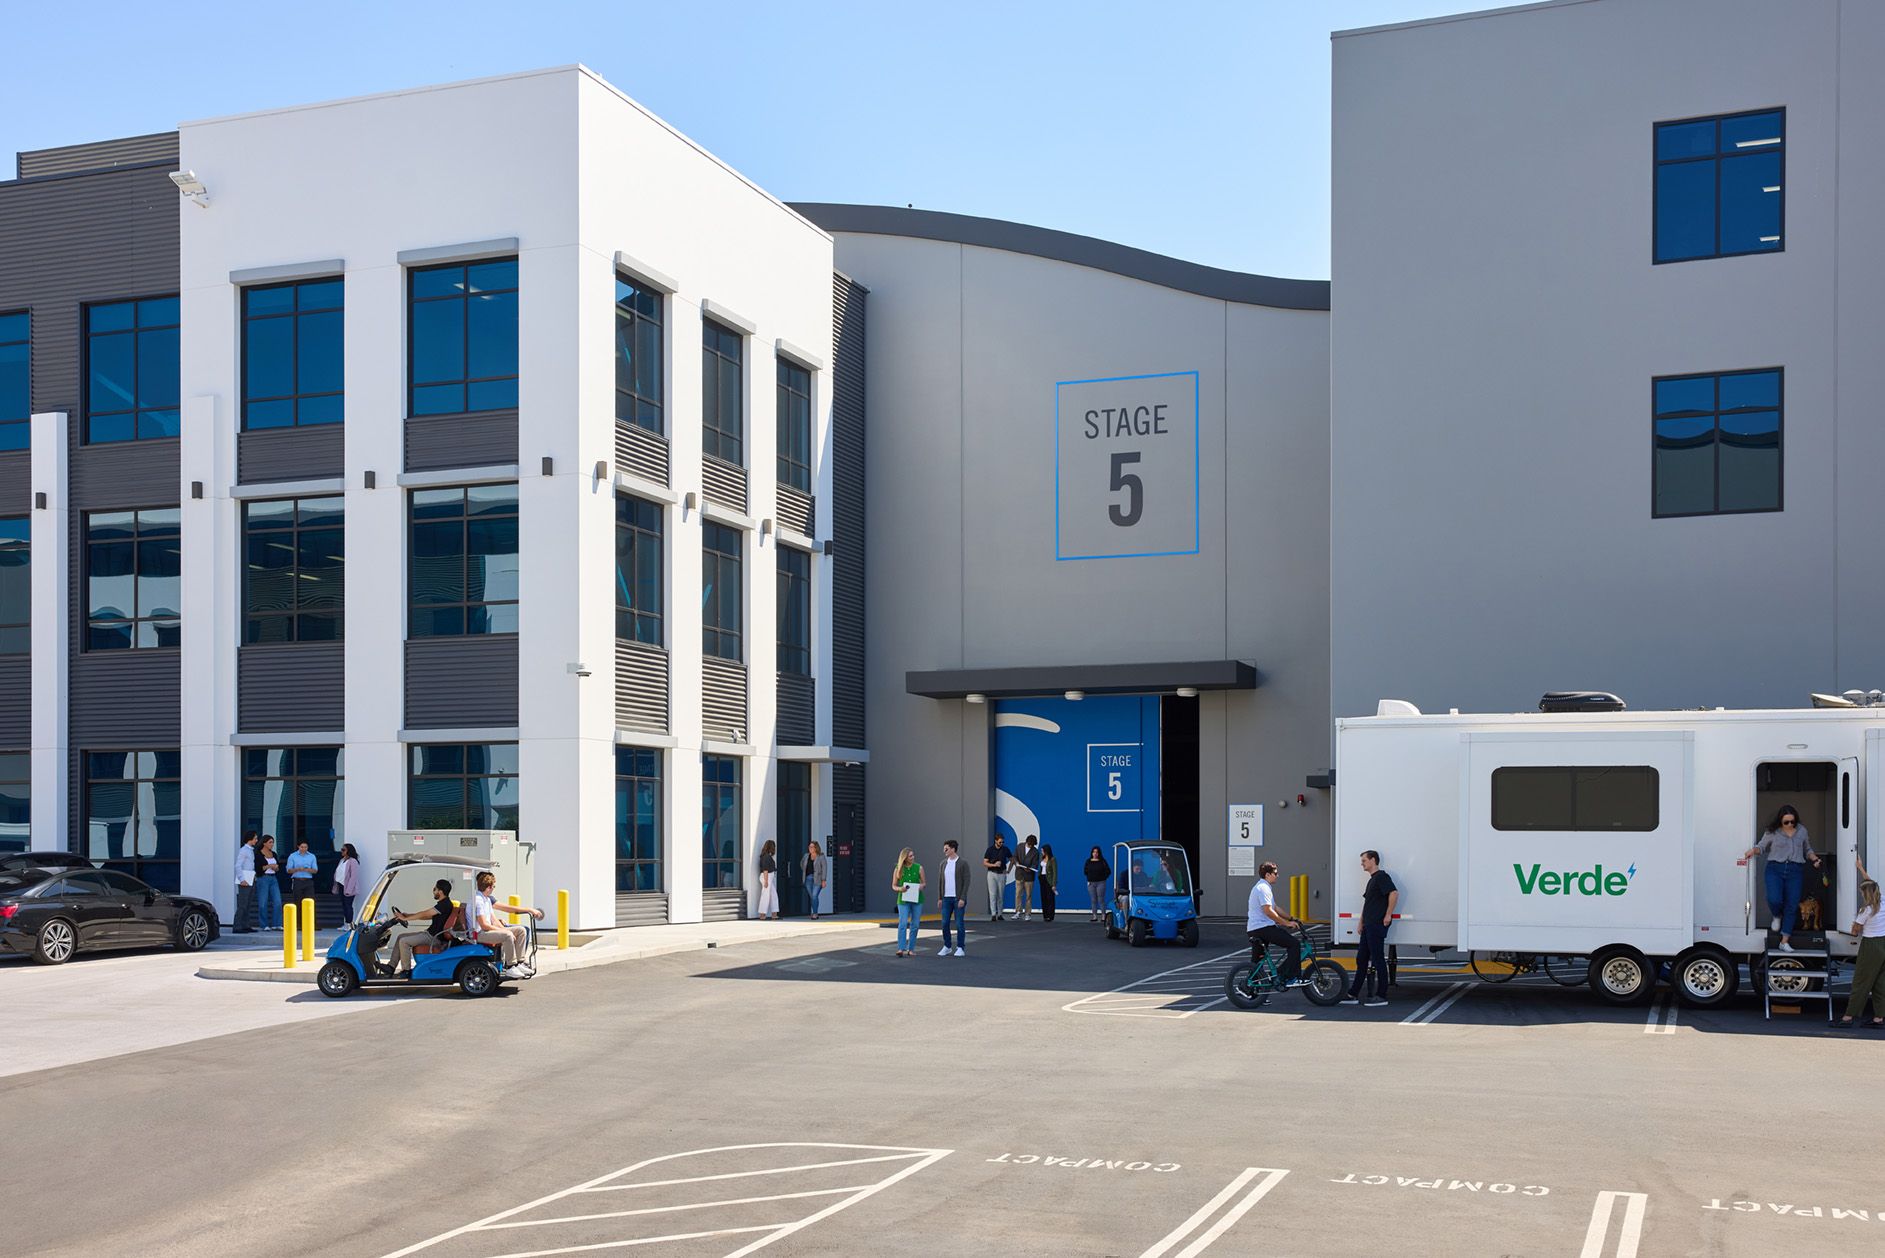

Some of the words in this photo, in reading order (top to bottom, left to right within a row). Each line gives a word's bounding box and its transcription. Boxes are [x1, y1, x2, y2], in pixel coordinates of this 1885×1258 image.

[1084, 404, 1168, 439] STAGE
[1108, 451, 1144, 527] 5
[1100, 755, 1131, 767] STAGE
[1108, 772, 1122, 800] 5
[1235, 810, 1256, 818] STAGE
[1241, 822, 1250, 839] 5
[1512, 863, 1627, 896] Verde
[985, 1153, 1182, 1172] COMPACT
[1329, 1173, 1550, 1196] COMPACT
[1701, 1198, 1885, 1222] MPACT
